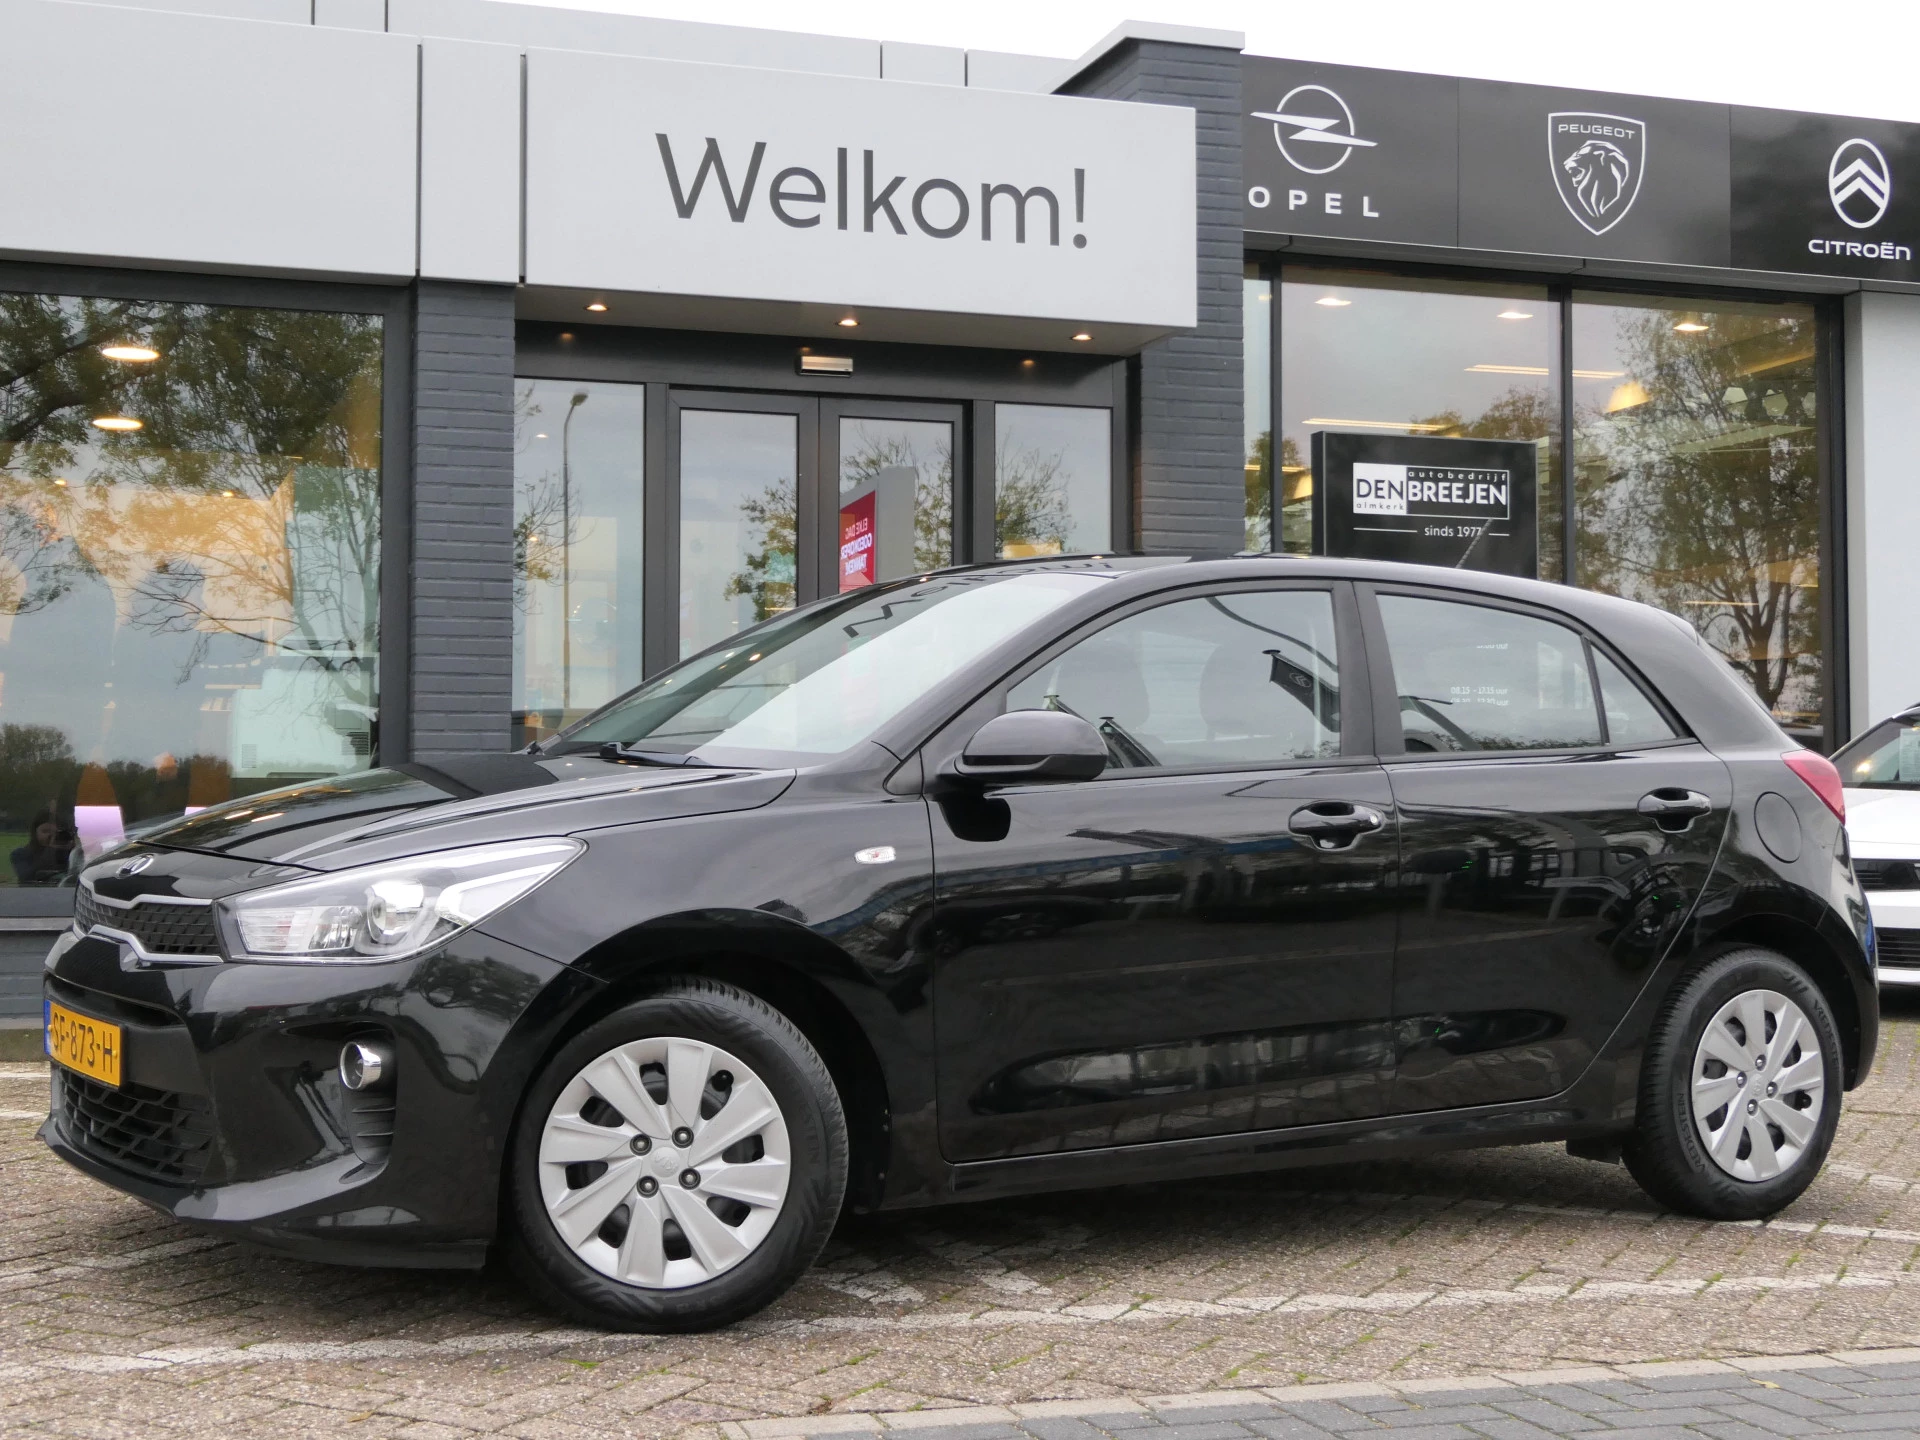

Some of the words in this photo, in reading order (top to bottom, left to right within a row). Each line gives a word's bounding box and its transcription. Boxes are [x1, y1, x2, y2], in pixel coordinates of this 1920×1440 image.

[1558, 123, 1636, 140] PEUGEOT
[655, 132, 1088, 249] Welkom!
[1248, 186, 1379, 218] OPEL
[1808, 238, 1911, 261] CITROËN
[1408, 470, 1507, 483] autobedrijf
[1356, 478, 1405, 500] DEN
[1408, 481, 1507, 505] BREEJEN
[1356, 501, 1405, 511] almkerk
[1424, 525, 1454, 537] sinds
[1457, 526, 1482, 538] 1977
[52, 1011, 114, 1073] SF-873-H
